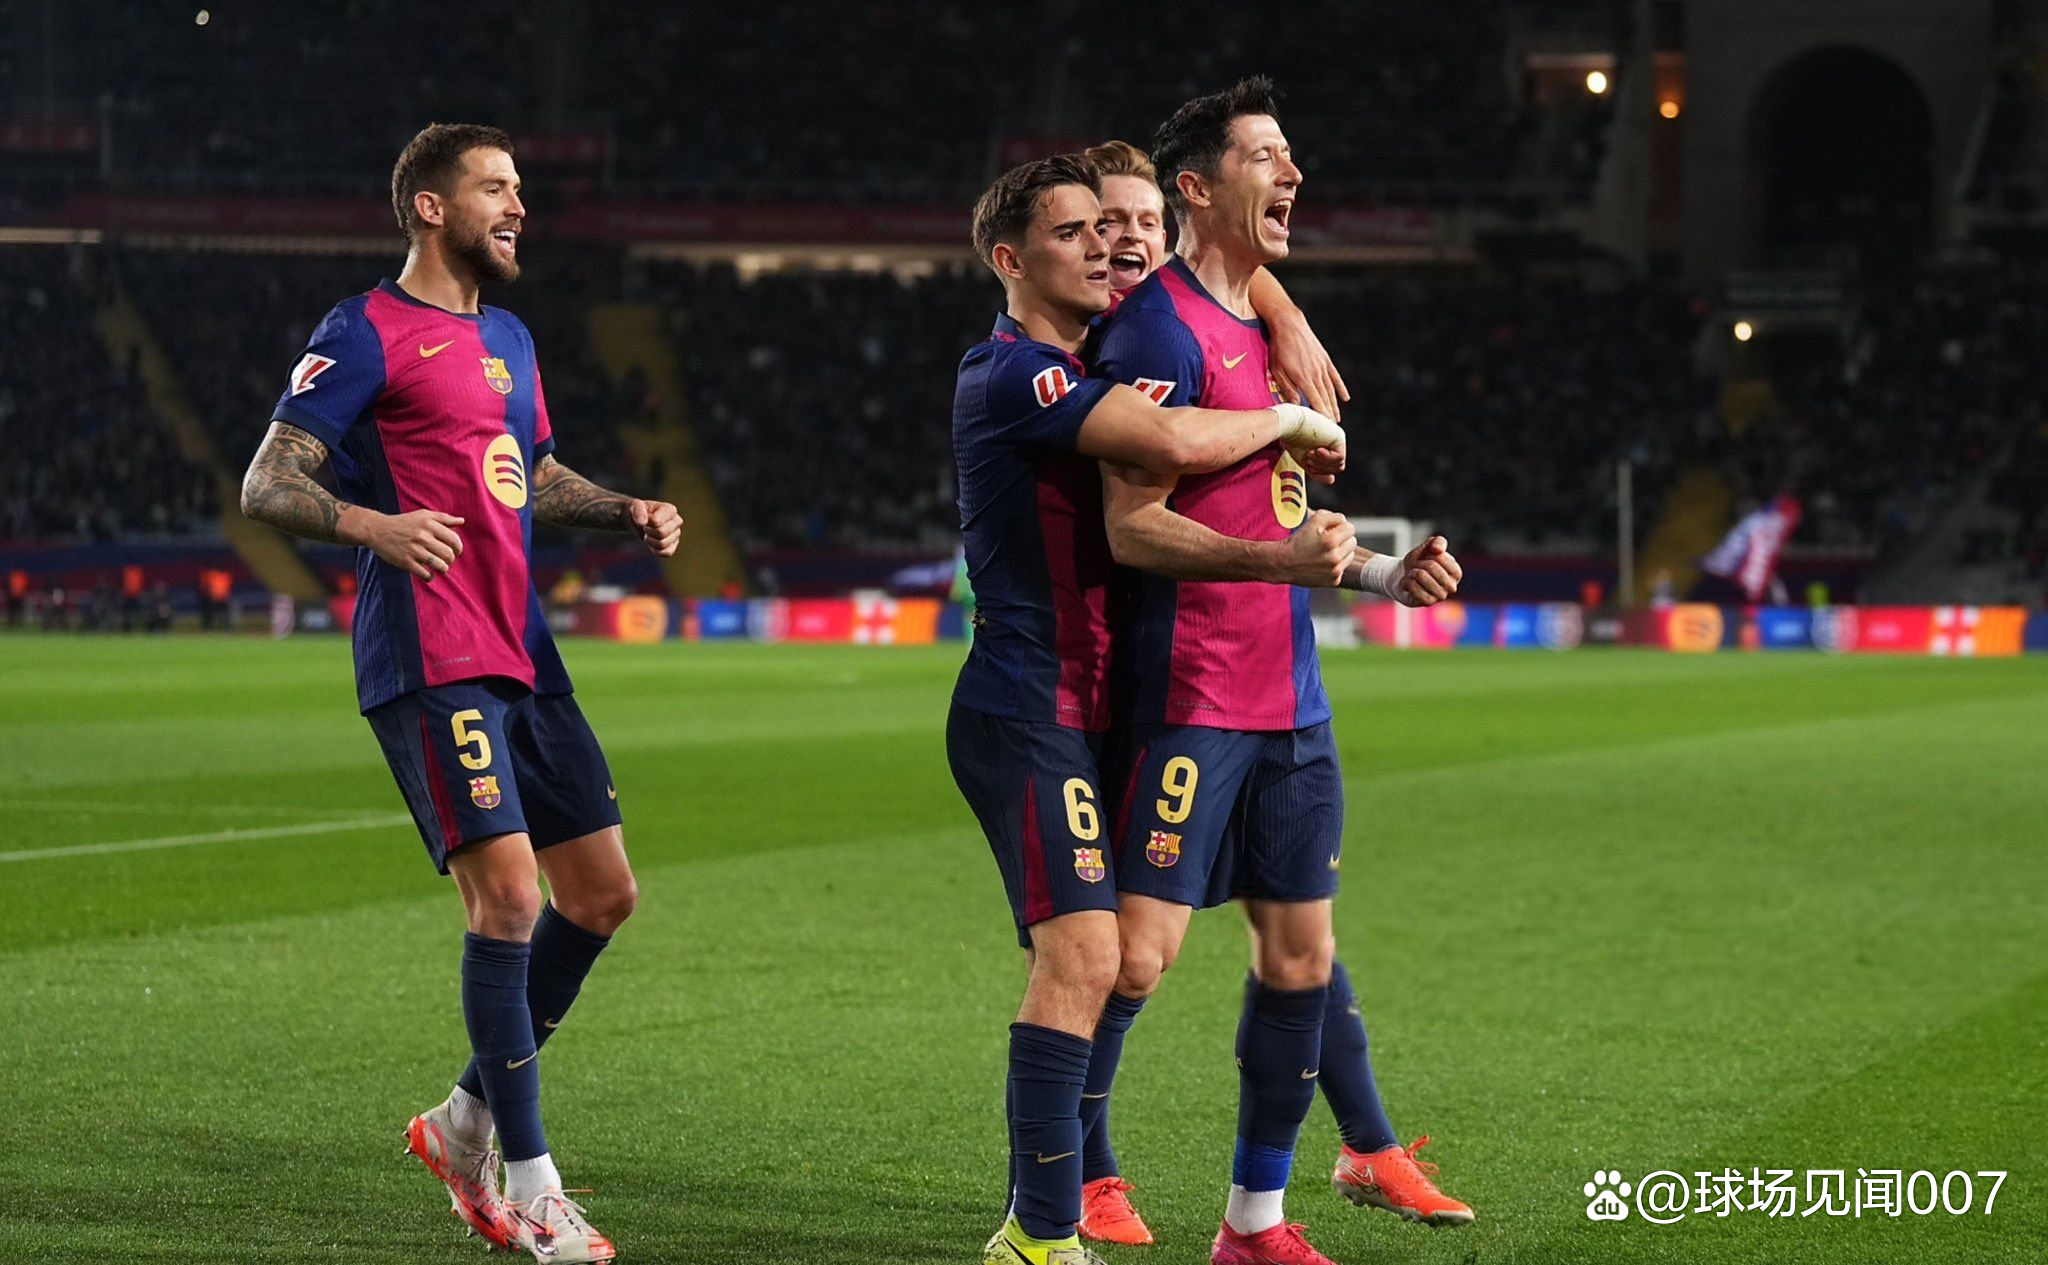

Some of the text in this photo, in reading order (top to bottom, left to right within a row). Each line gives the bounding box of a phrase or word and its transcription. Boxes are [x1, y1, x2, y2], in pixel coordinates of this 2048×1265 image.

[451, 709, 491, 770] 5
[1063, 778, 1099, 840] 6
[1157, 756, 1198, 823] 9
